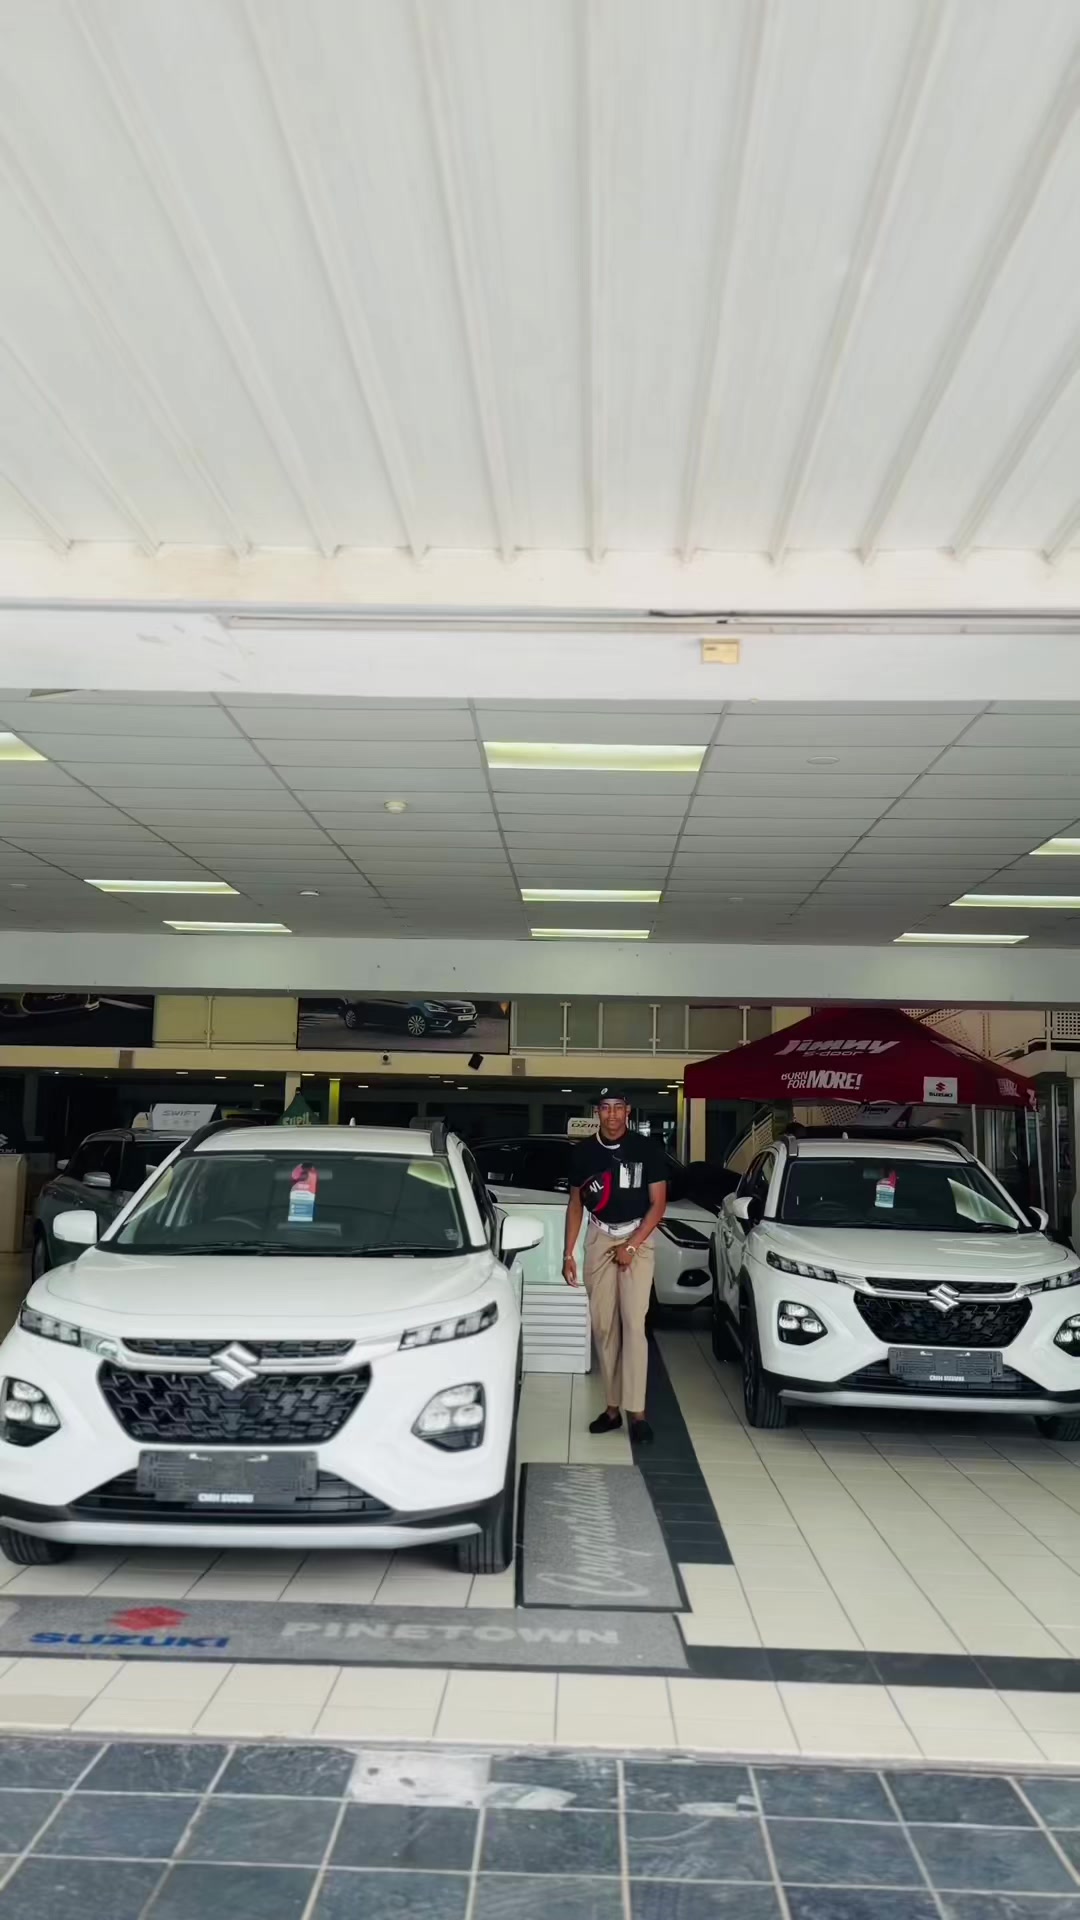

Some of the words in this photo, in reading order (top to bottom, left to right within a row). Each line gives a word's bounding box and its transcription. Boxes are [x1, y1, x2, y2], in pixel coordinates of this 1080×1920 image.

[774, 1039, 900, 1056] Jimny
[781, 1071, 808, 1081] BORN
[787, 1079, 807, 1089] FOR
[806, 1069, 863, 1090] MORE!
[29, 1632, 230, 1648] SUZUKI
[281, 1621, 621, 1644] PINETOWN
